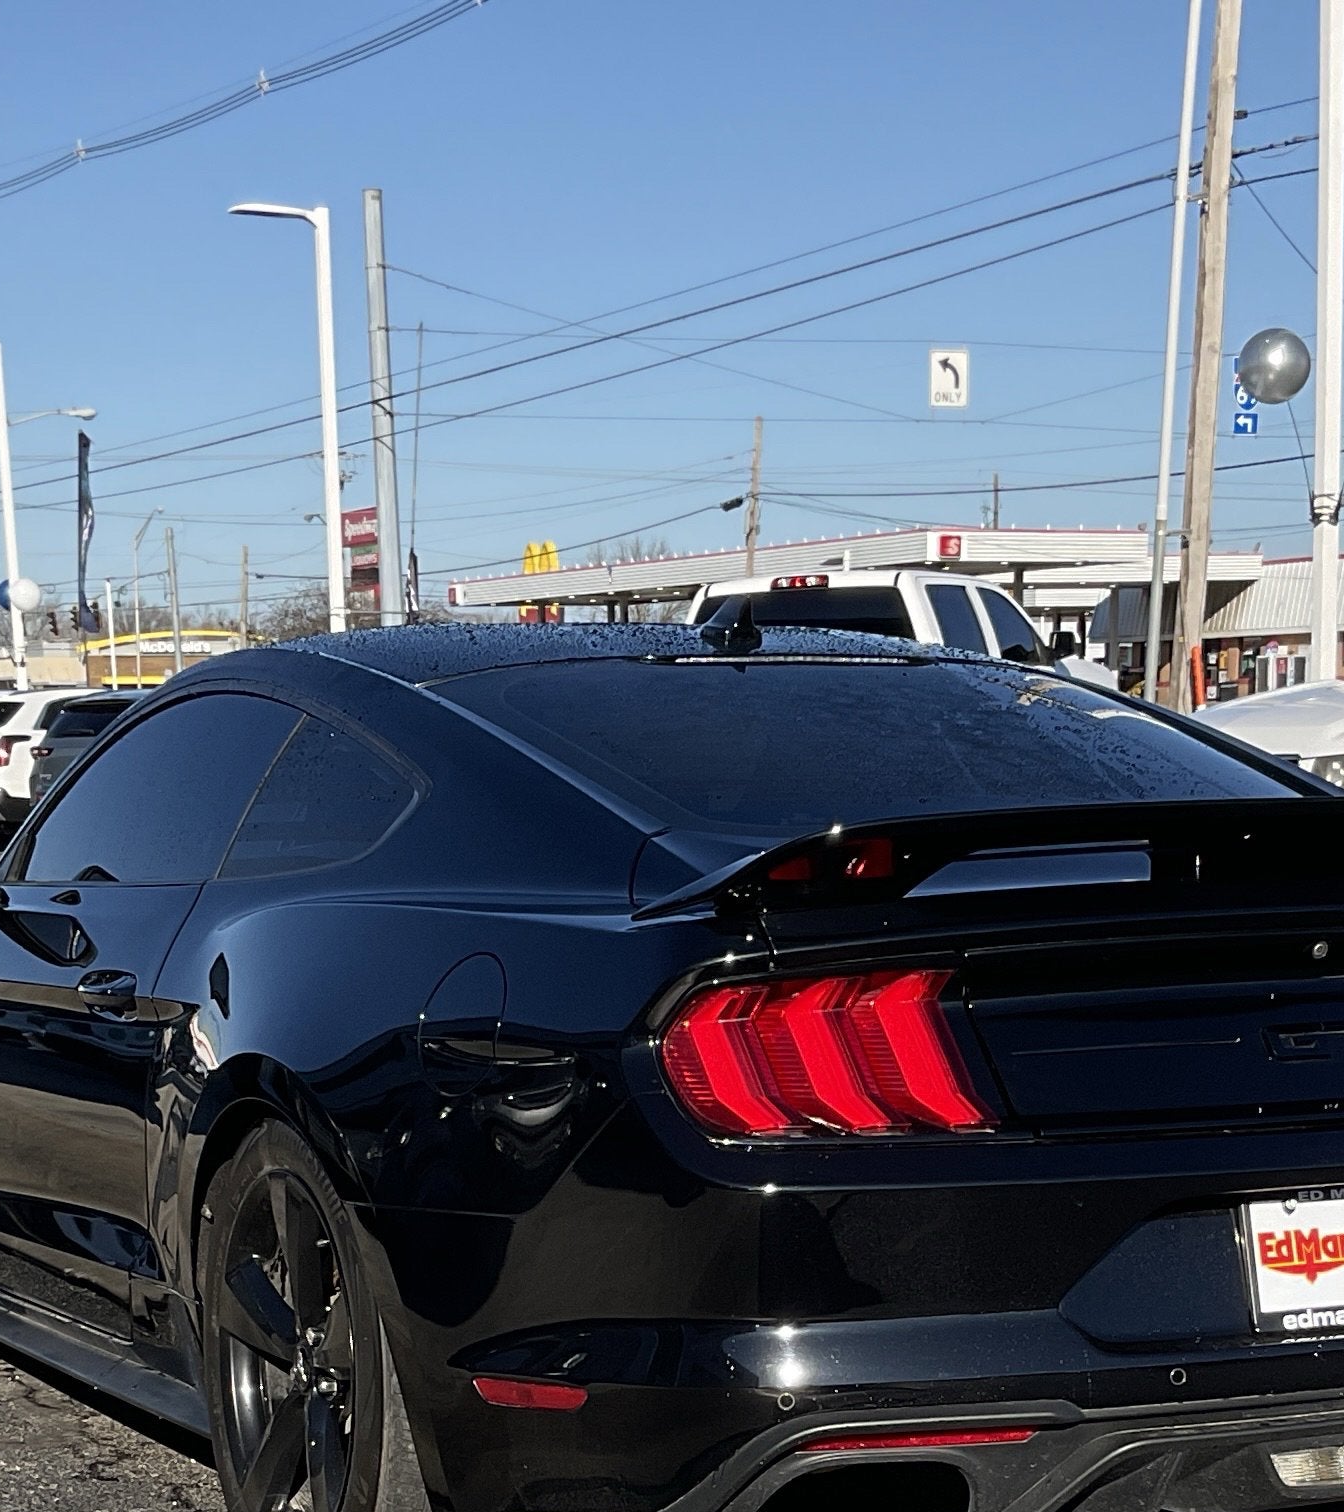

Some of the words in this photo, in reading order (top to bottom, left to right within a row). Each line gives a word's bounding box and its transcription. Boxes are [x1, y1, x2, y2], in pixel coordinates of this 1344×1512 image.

[934, 392, 962, 403] ONLY
[1236, 385, 1257, 405] 6
[140, 640, 211, 653] McDoald's
[1298, 1189, 1324, 1202] ED
